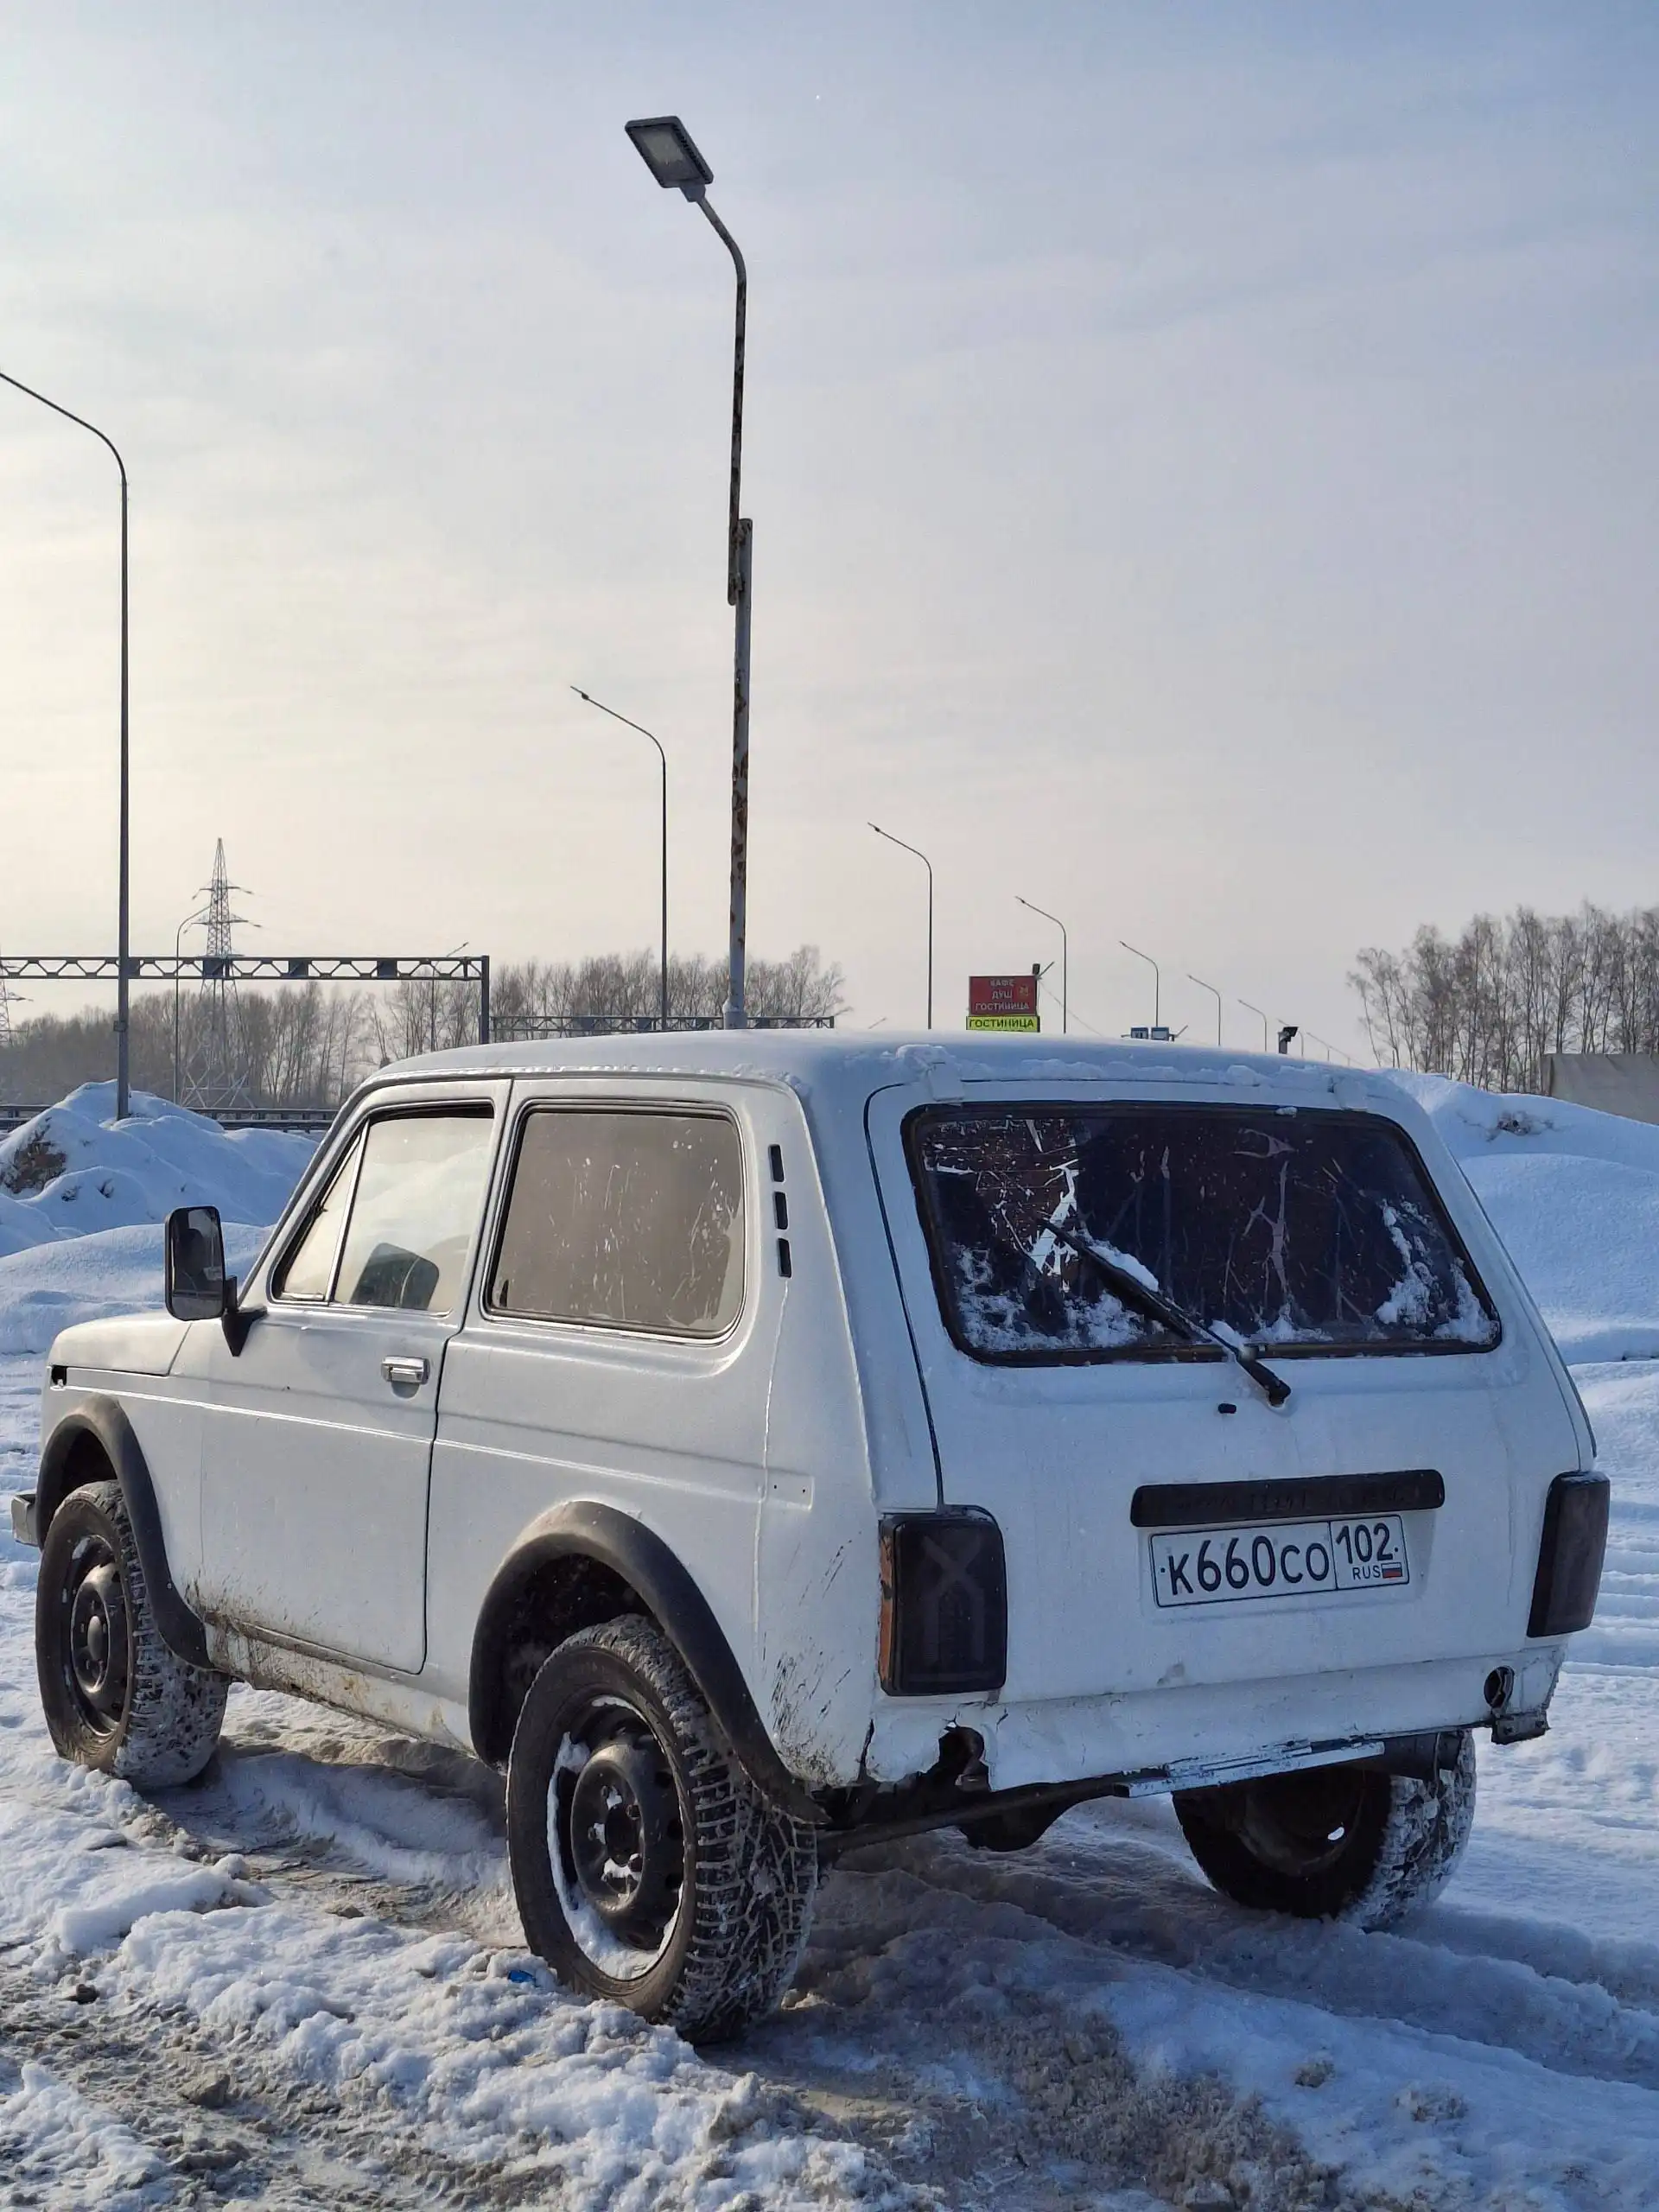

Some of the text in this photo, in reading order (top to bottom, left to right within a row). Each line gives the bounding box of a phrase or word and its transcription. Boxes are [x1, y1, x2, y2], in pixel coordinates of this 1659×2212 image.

[992, 989, 1013, 1000] ДУШ
[969, 1019, 1034, 1028] ГОСТИНИЦА
[1335, 1522, 1393, 1563] 102
[1352, 1566, 1381, 1580] RUS
